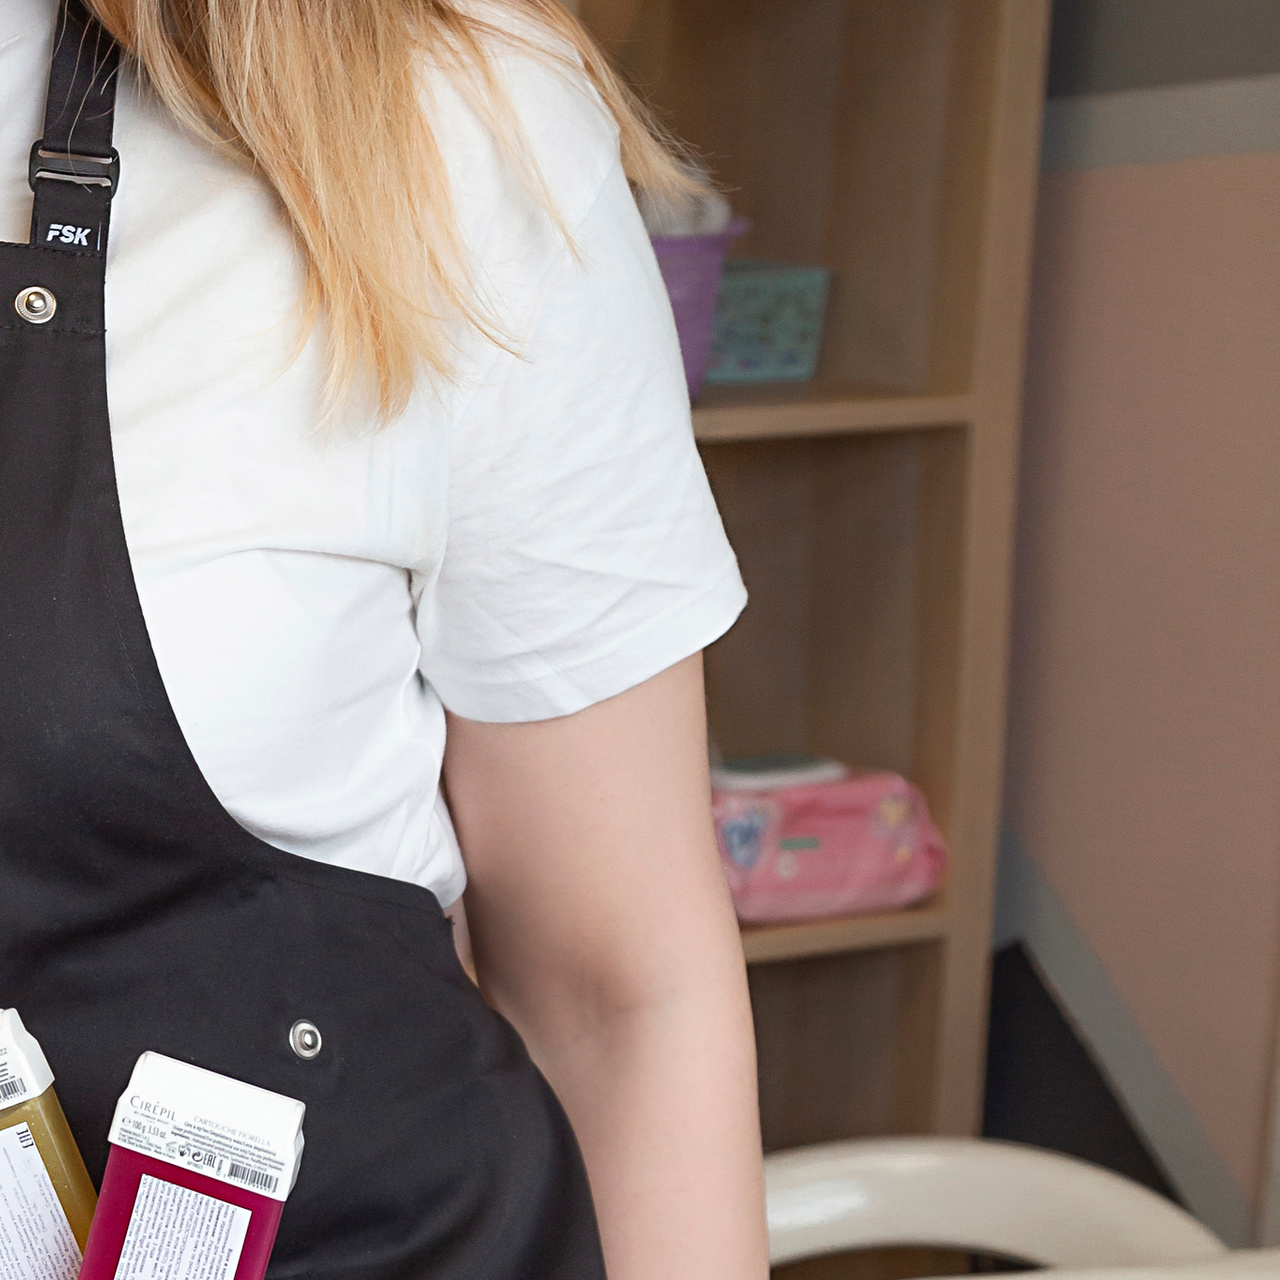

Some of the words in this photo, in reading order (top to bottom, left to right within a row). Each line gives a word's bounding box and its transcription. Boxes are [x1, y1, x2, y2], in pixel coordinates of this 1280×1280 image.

[47, 224, 91, 246] FSK
[130, 1095, 175, 1121] CIRÉPIL
[133, 1120, 142, 1130] 100
[147, 1125, 160, 1137] 3.53
[194, 1116, 237, 1136] CARTOUCHE
[239, 1131, 270, 1147] FIORELLA
[203, 1153, 217, 1168] EAC
